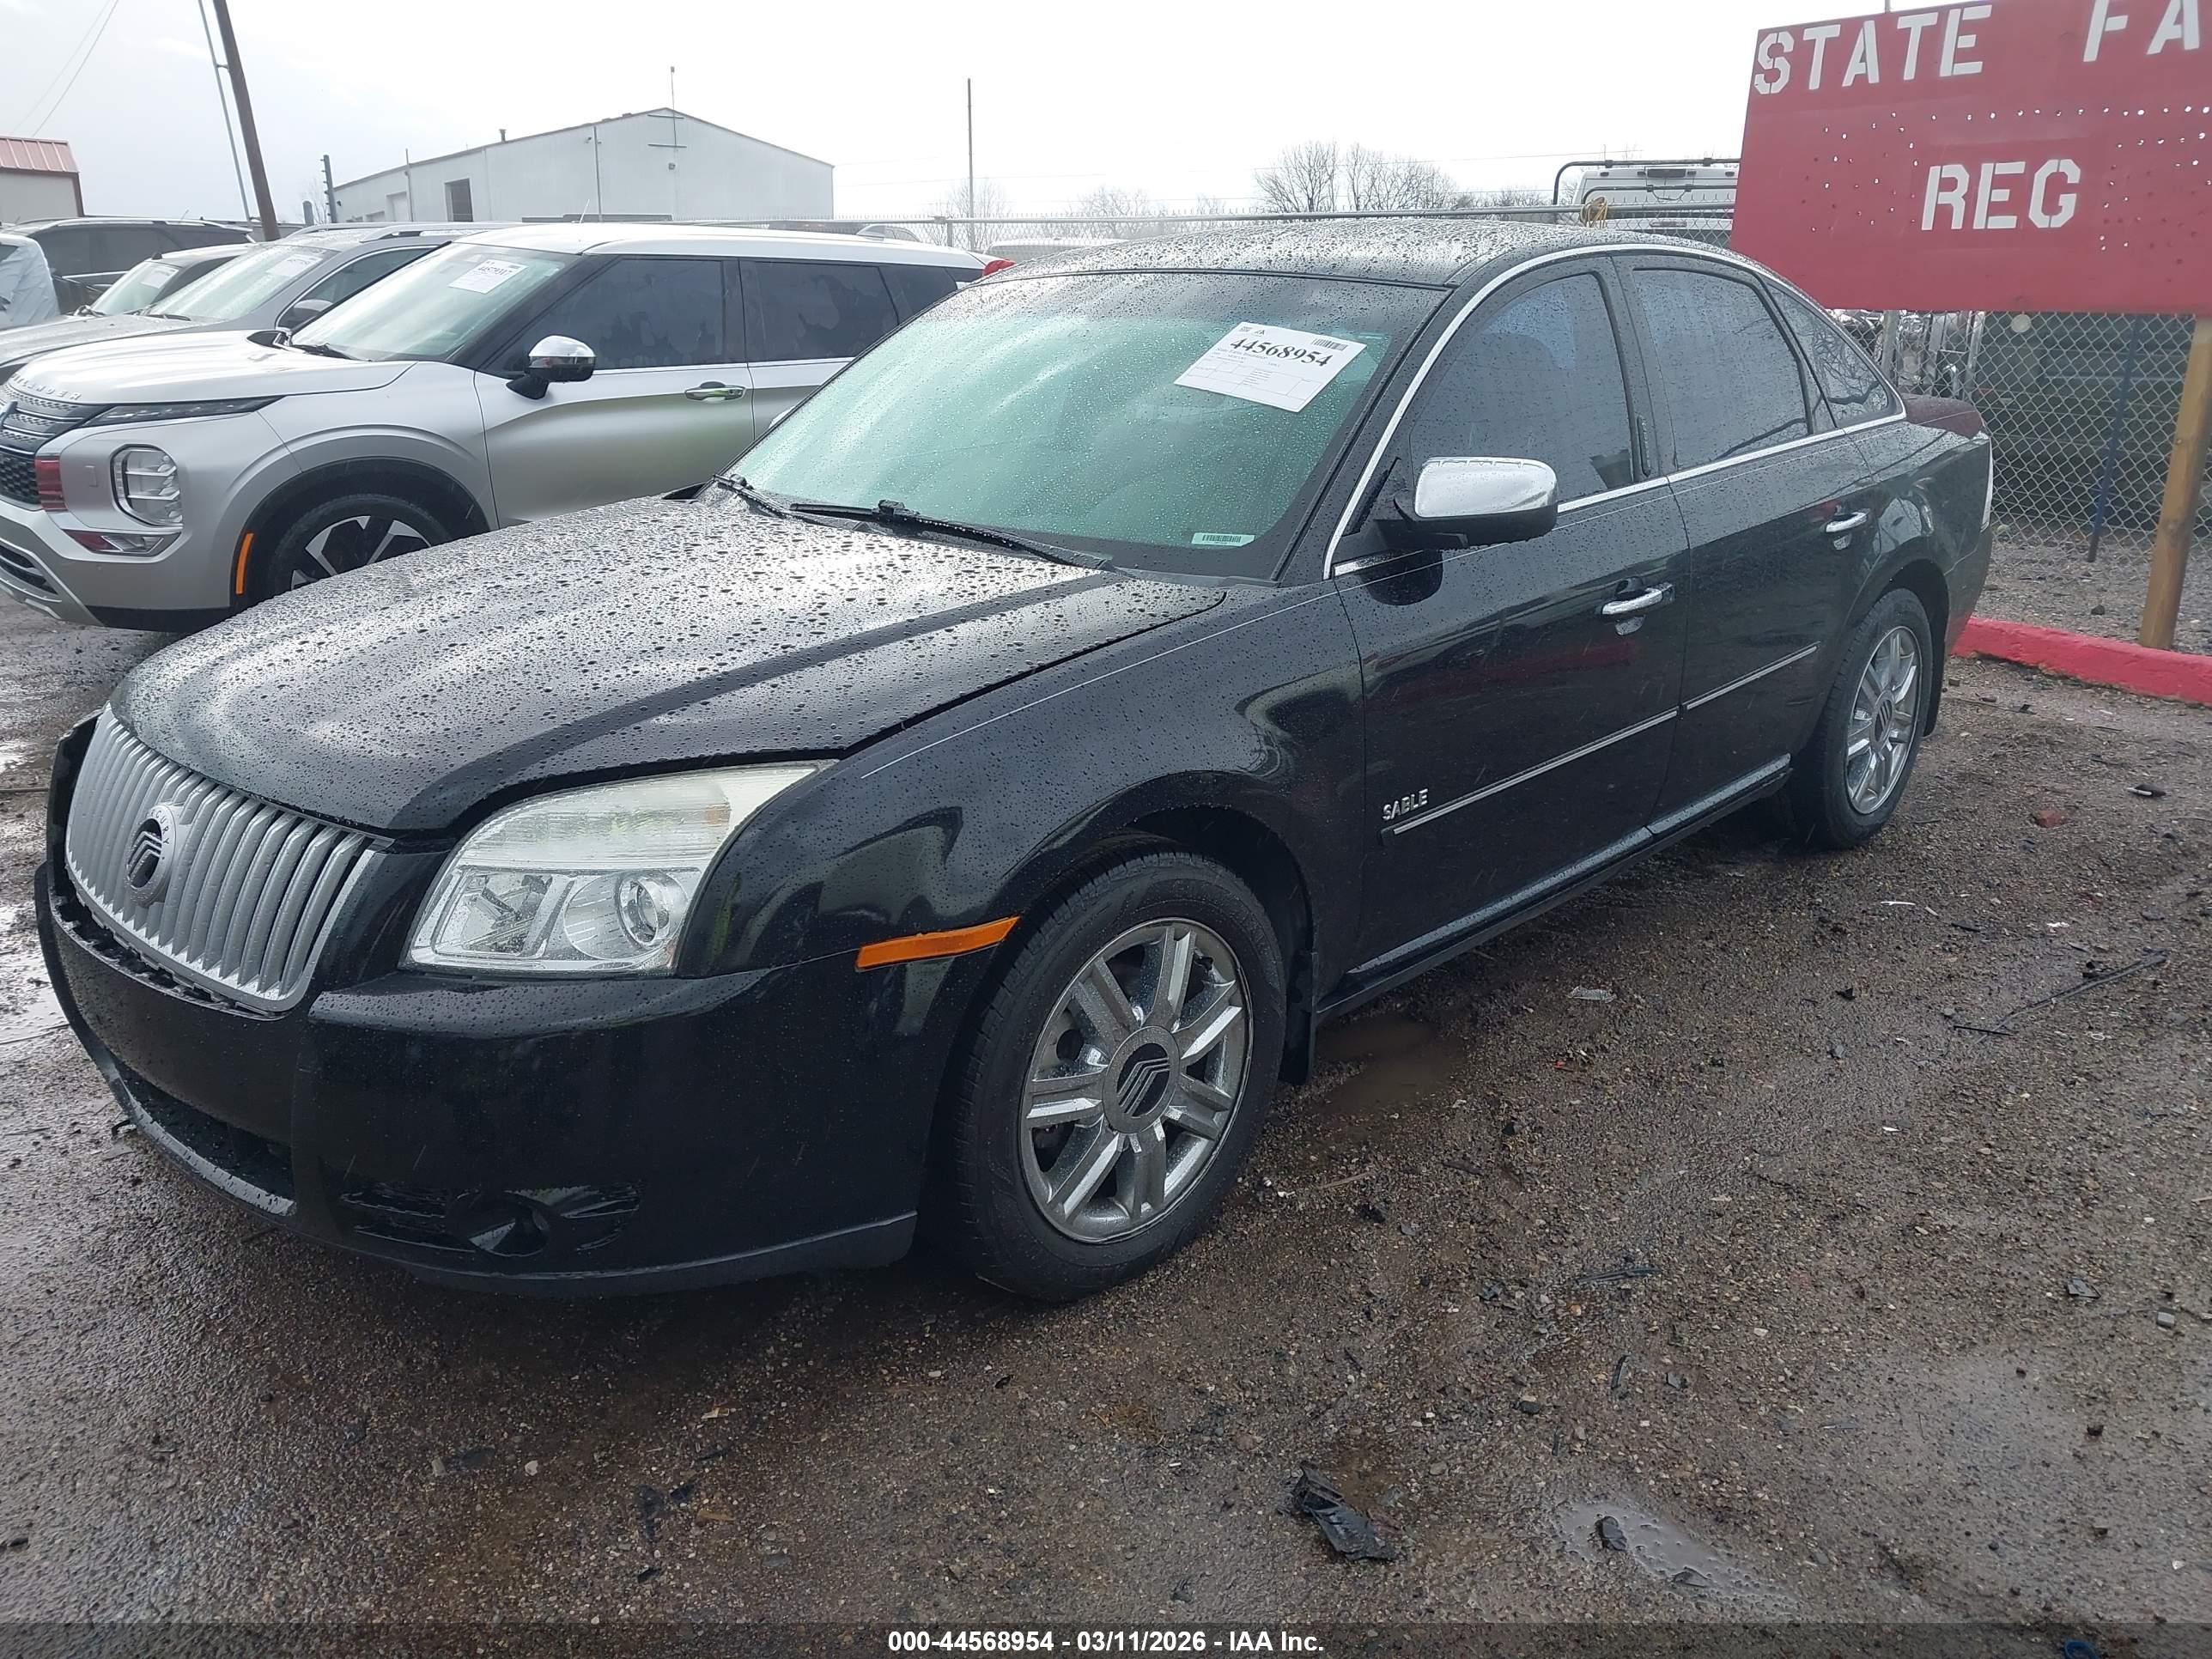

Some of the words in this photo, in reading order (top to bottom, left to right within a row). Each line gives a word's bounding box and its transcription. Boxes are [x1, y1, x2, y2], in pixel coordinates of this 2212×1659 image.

[1754, 4, 1993, 95] STATE
[1921, 158, 2082, 230] REG
[1230, 337, 1334, 368] 44568954
[1382, 788, 1429, 820] SABLE
